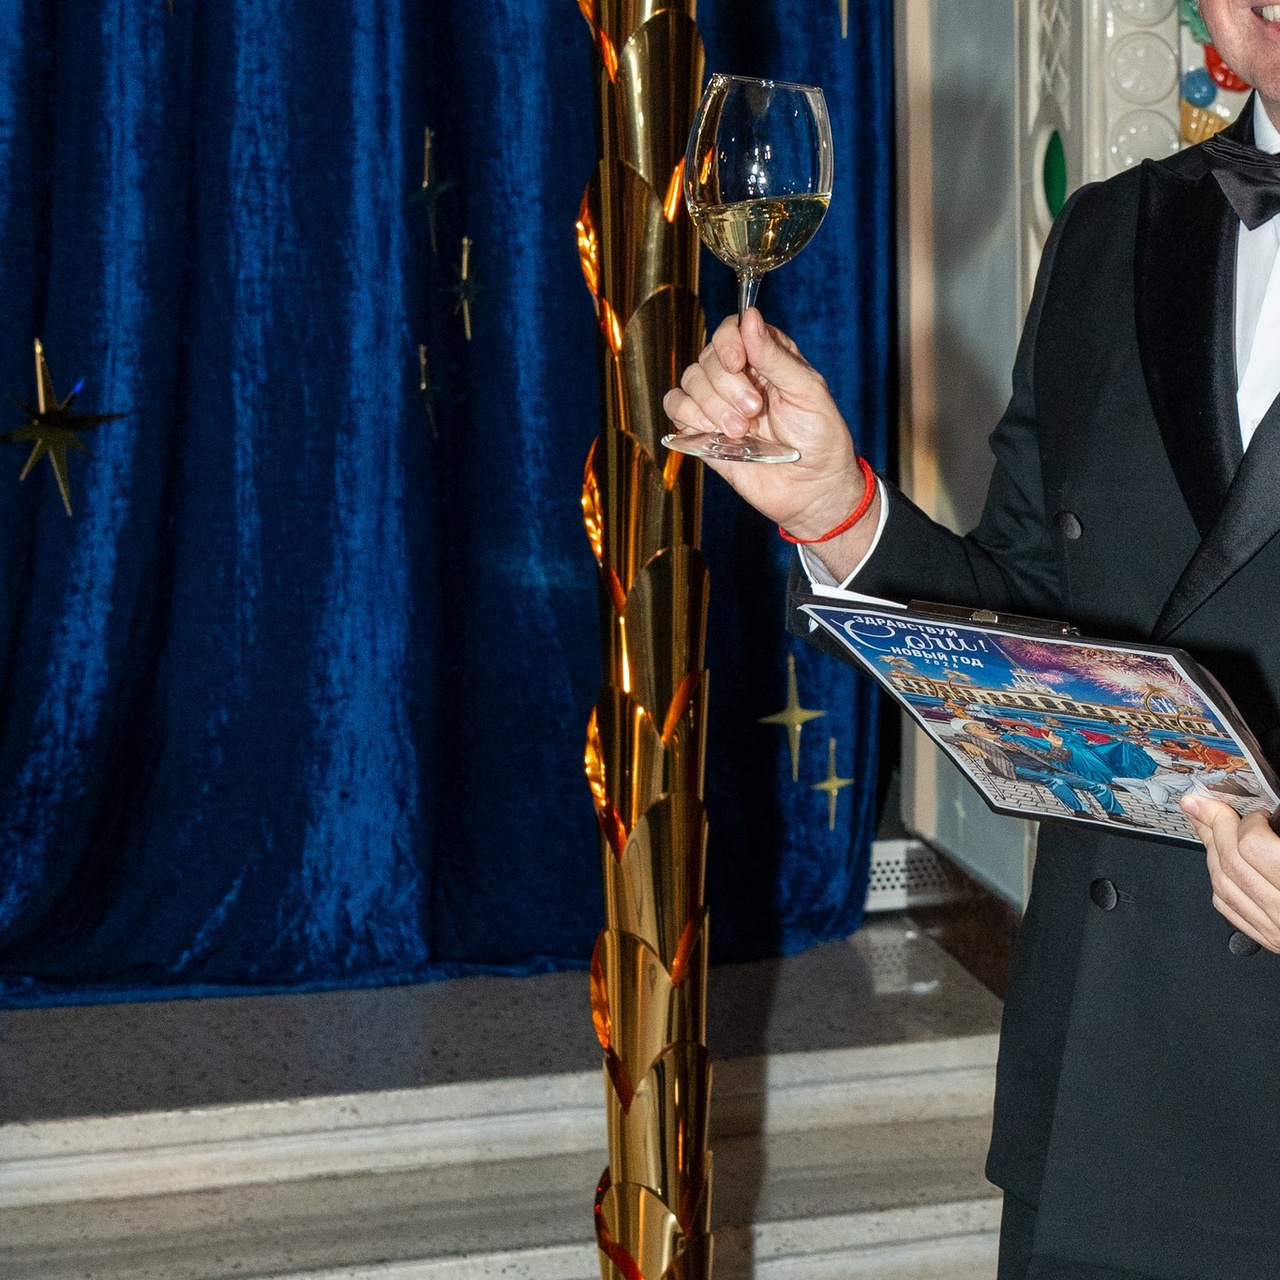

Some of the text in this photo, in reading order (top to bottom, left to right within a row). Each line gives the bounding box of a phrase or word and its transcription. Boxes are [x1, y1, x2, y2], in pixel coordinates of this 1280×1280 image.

[852, 615, 957, 637] ЗДРАВСТВУЙ
[889, 646, 984, 668] НОВЫЙ ГОД
[924, 658, 959, 669] 2026
